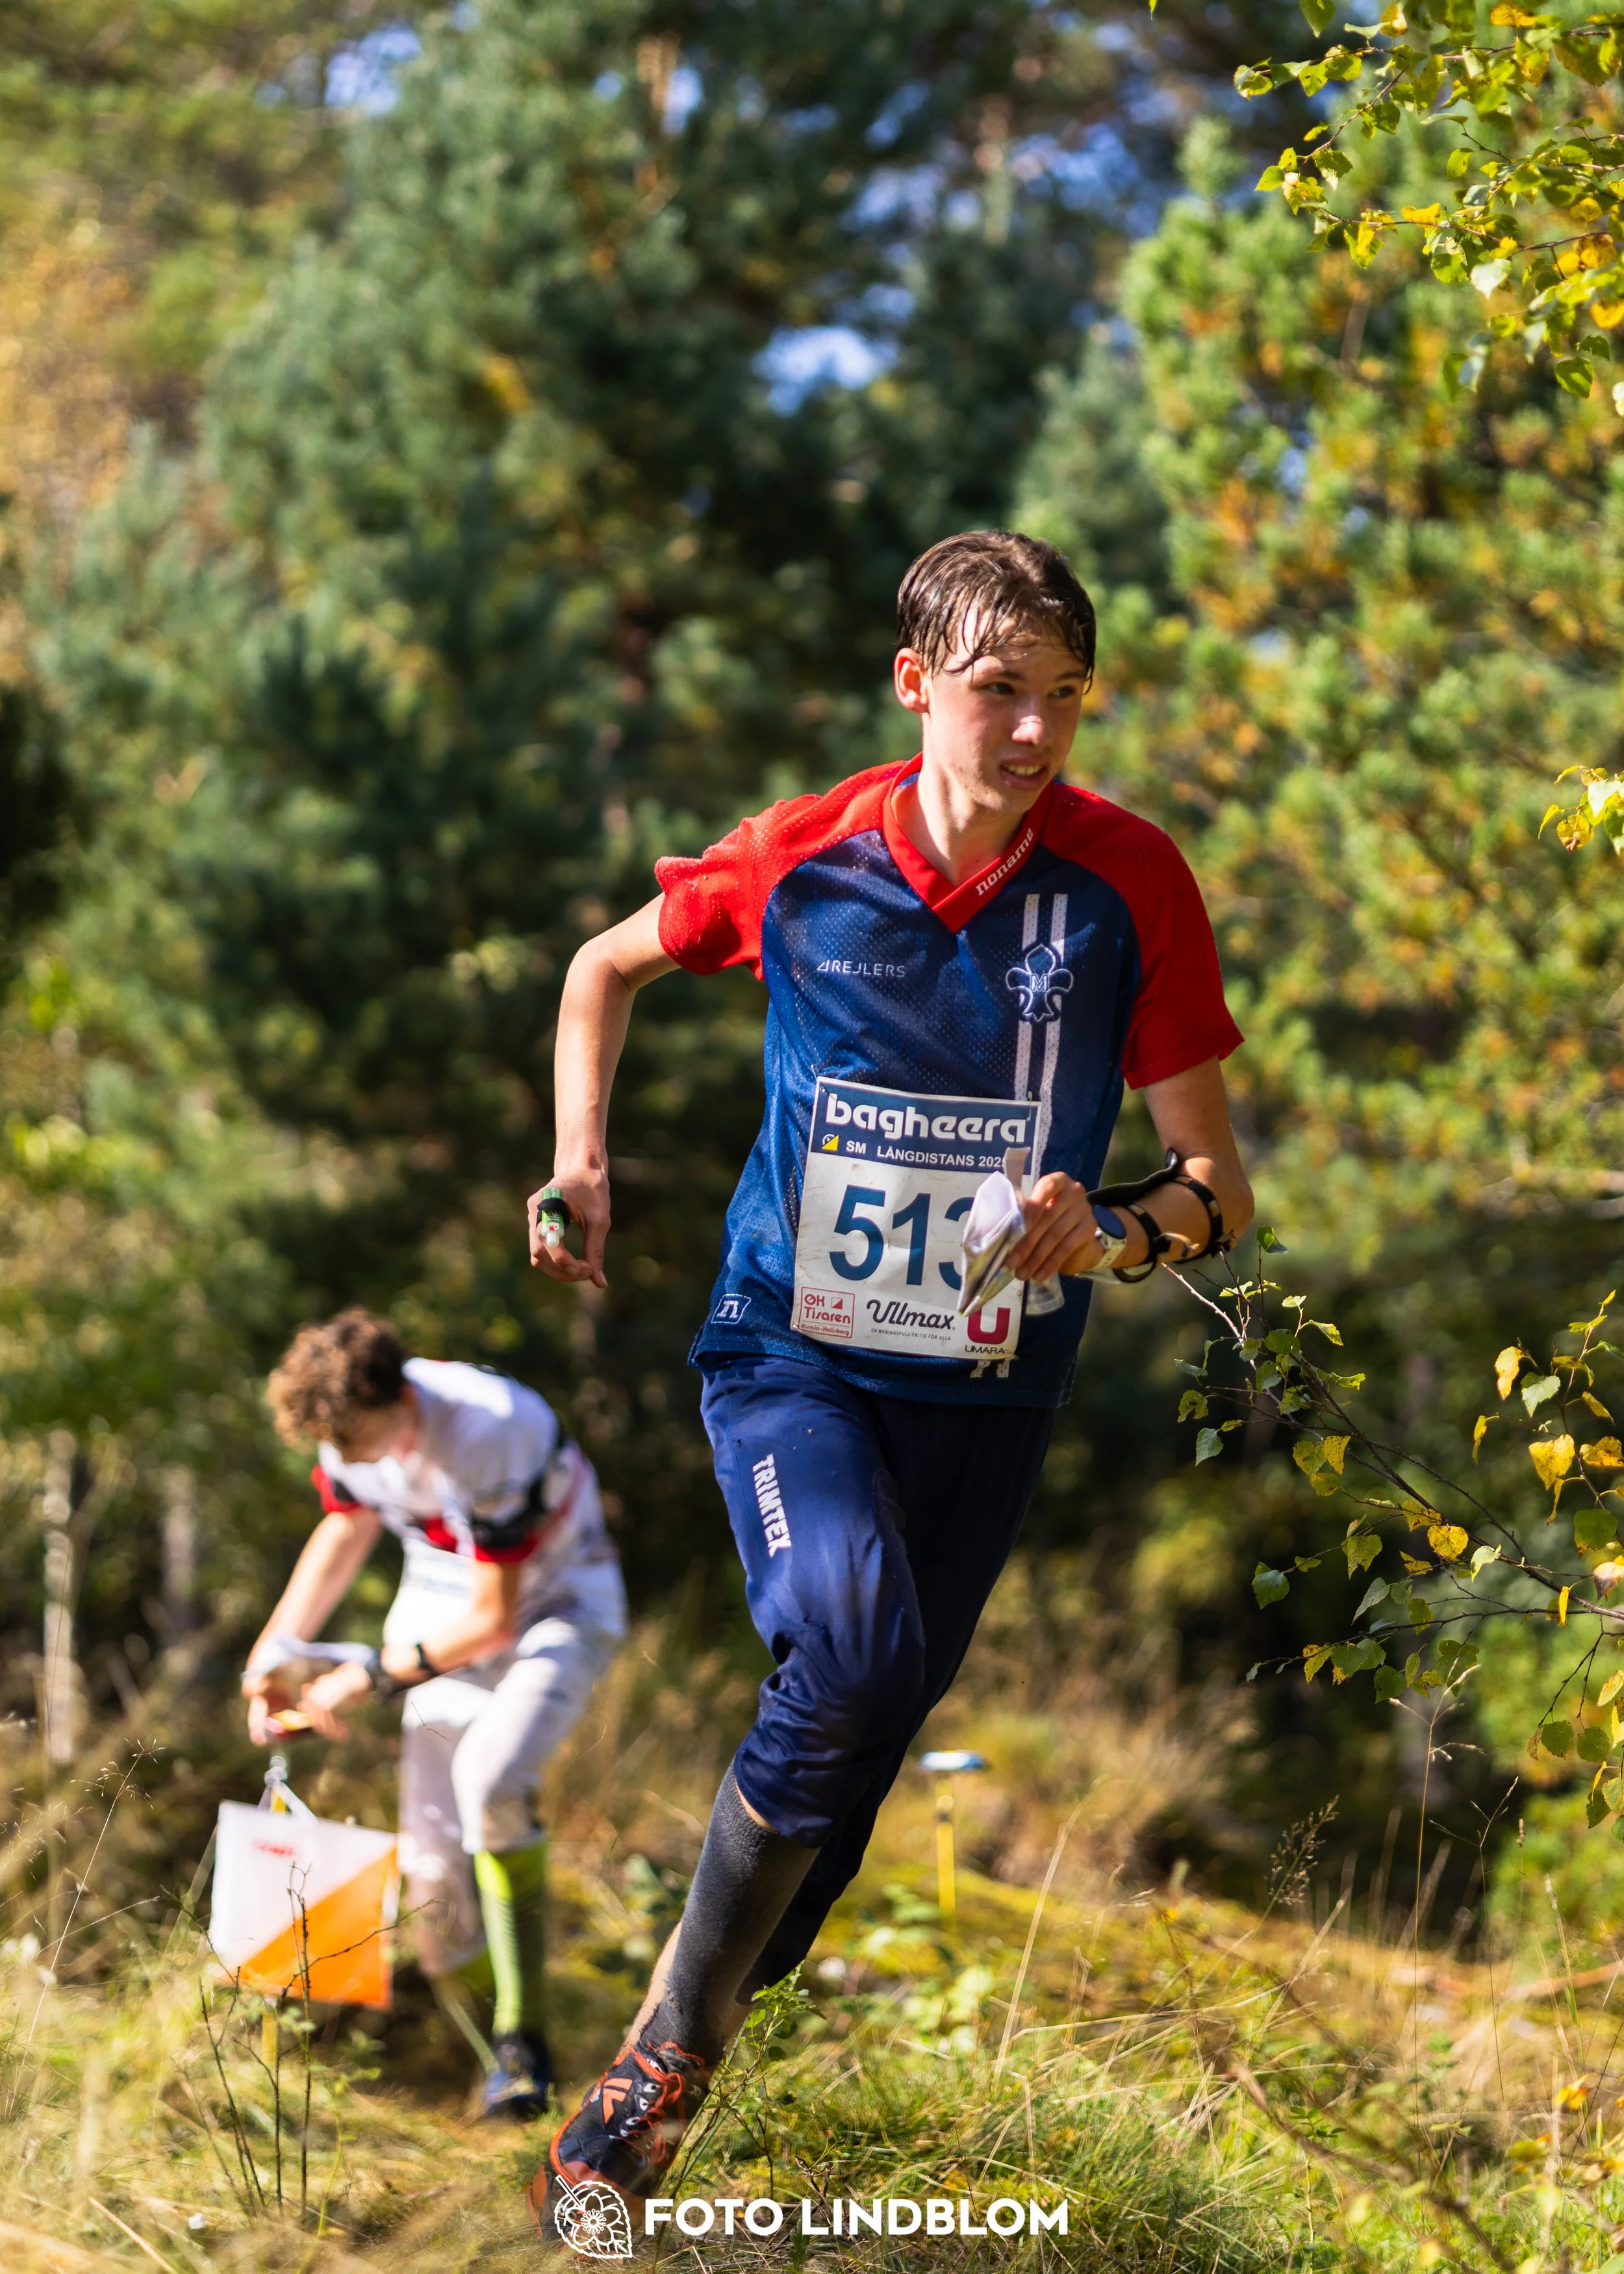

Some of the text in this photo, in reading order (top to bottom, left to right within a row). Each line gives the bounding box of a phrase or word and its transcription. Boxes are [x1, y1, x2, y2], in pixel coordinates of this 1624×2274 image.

[976, 828, 1034, 896] noname
[1030, 973, 1050, 991] M
[826, 1093, 1026, 1143] bagheera
[846, 1140, 866, 1154] SM
[877, 1145, 974, 1166] LÅNGDISTANS
[804, 1307, 850, 1323] Tisaren
[867, 1299, 954, 1329] Ullmax
[965, 1345, 1005, 1354] UMARA
[753, 1453, 792, 1557] TRIMTEX
